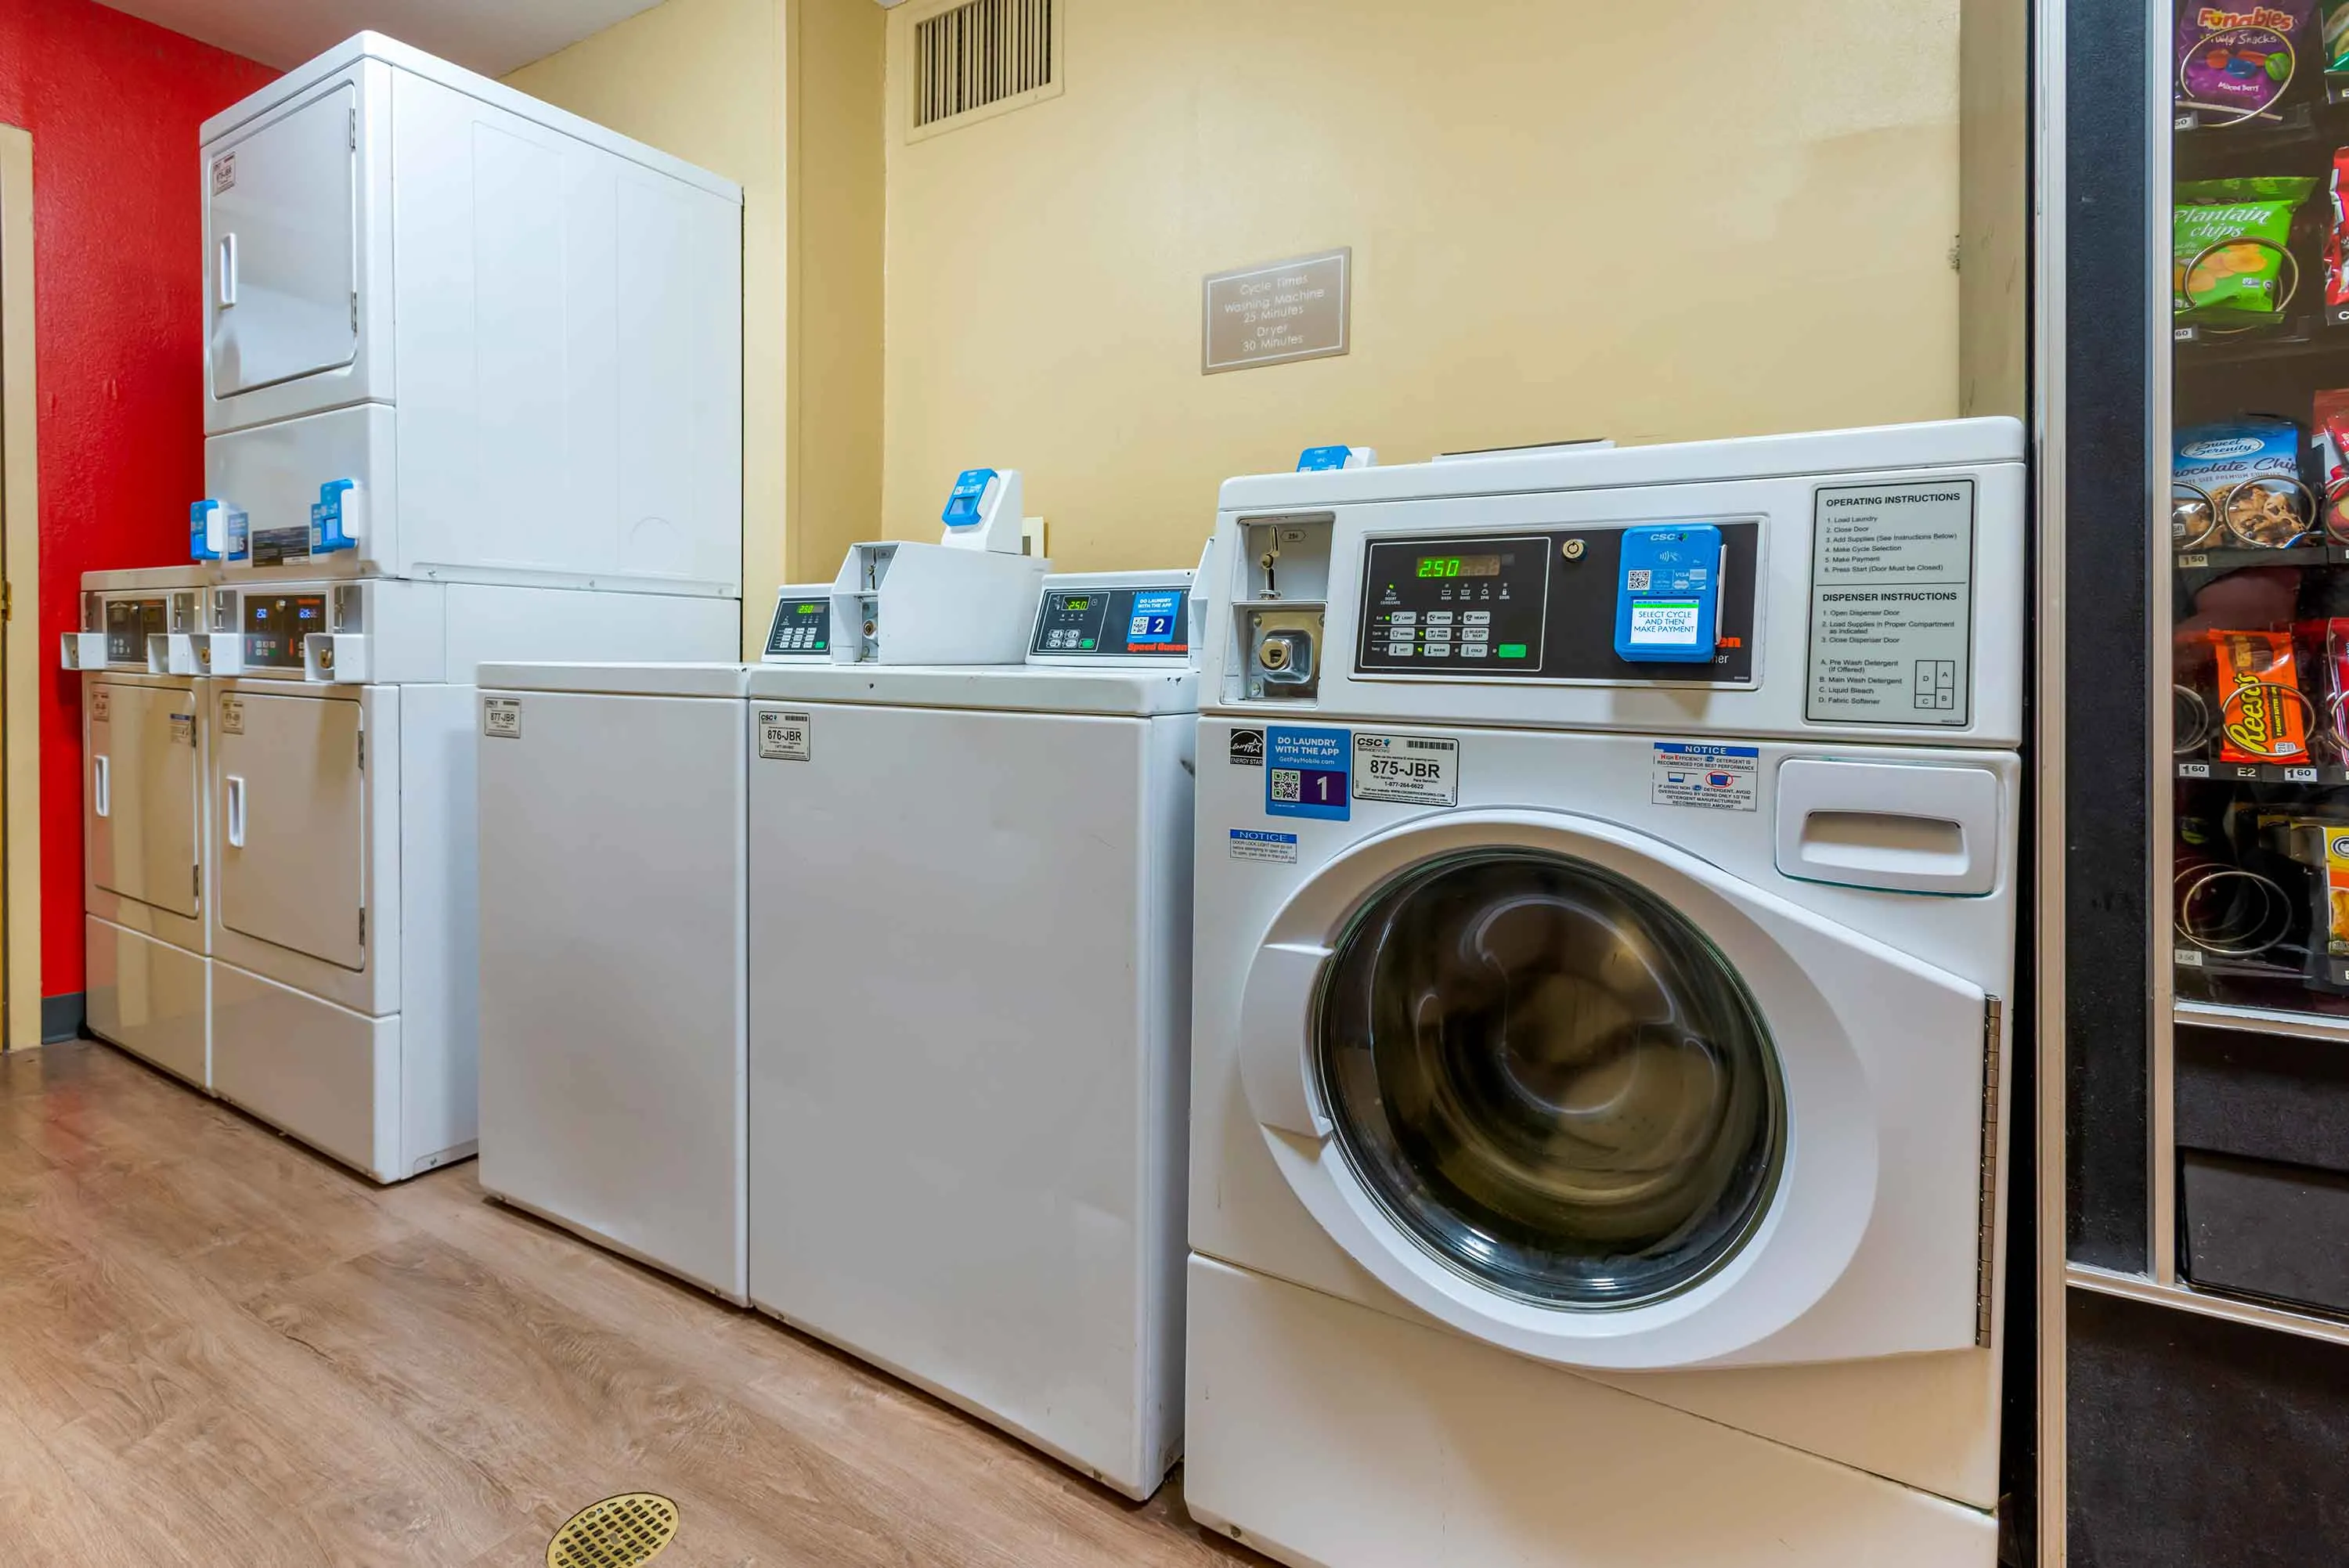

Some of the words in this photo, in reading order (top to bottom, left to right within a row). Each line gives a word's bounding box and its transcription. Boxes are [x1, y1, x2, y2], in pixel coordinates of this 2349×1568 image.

[2197, 6, 2293, 31] Funables
[2237, 34, 2277, 45] Snacks
[2242, 84, 2260, 92] Berry
[2174, 207, 2272, 225] Plantain
[2191, 222, 2246, 242] chips
[1239, 281, 1272, 295] Cycle
[1277, 275, 1309, 287] Times
[1225, 298, 1270, 314] Washing
[1275, 288, 1325, 305] Machine
[1244, 313, 1256, 323] 25
[1261, 305, 1304, 320] Minutes
[1257, 323, 1288, 337] Dryer
[1243, 341, 1256, 351] 30
[1261, 334, 1304, 349] Minutes
[2193, 445, 2252, 456] Serenity
[2198, 438, 2241, 449] Sweet
[2173, 461, 2248, 478] ocolate
[1826, 496, 1882, 507] OPERATING
[1885, 492, 1961, 504] INSTRUCTIONS
[1418, 560, 1460, 577] 2.50
[1881, 593, 1958, 601] INSTRUCTIONS
[1153, 618, 1164, 633] 2
[1158, 643, 1188, 651] Queen
[2228, 672, 2268, 752] Reese's
[767, 730, 802, 741] 876-JBR
[1293, 737, 1337, 747] LAUNDRY
[1357, 737, 1383, 747] CSC
[1275, 745, 1299, 754] WITH
[1320, 748, 1340, 756] APP
[1685, 745, 1727, 755] NOTICE
[1279, 756, 1335, 765] GetPayMobile.com
[1370, 759, 1440, 778] 875-JBR
[2237, 767, 2256, 777] E2
[1317, 776, 1327, 801] 1
[1239, 831, 1287, 842] NOTICE
